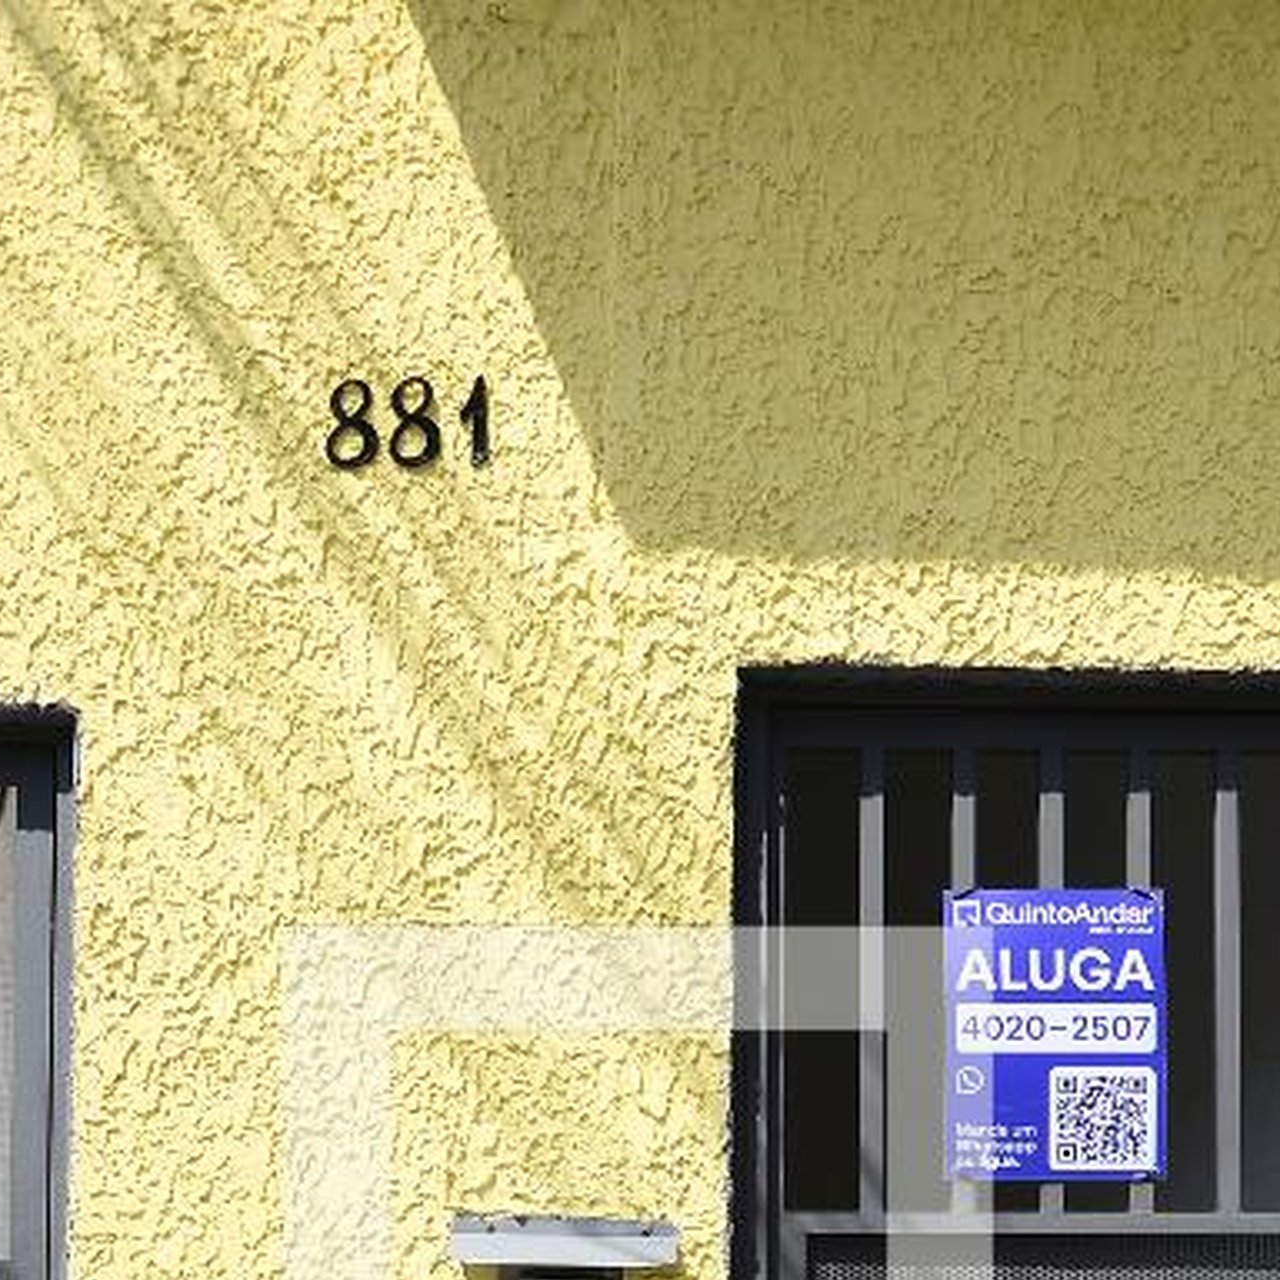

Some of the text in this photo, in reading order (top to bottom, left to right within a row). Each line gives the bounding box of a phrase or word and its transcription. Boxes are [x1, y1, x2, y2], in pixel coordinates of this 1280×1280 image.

[326, 374, 490, 469] 881
[986, 902, 1154, 926] QuintoAndar
[956, 948, 1155, 992] ALUGA
[961, 1015, 1151, 1042] 4020-2507
